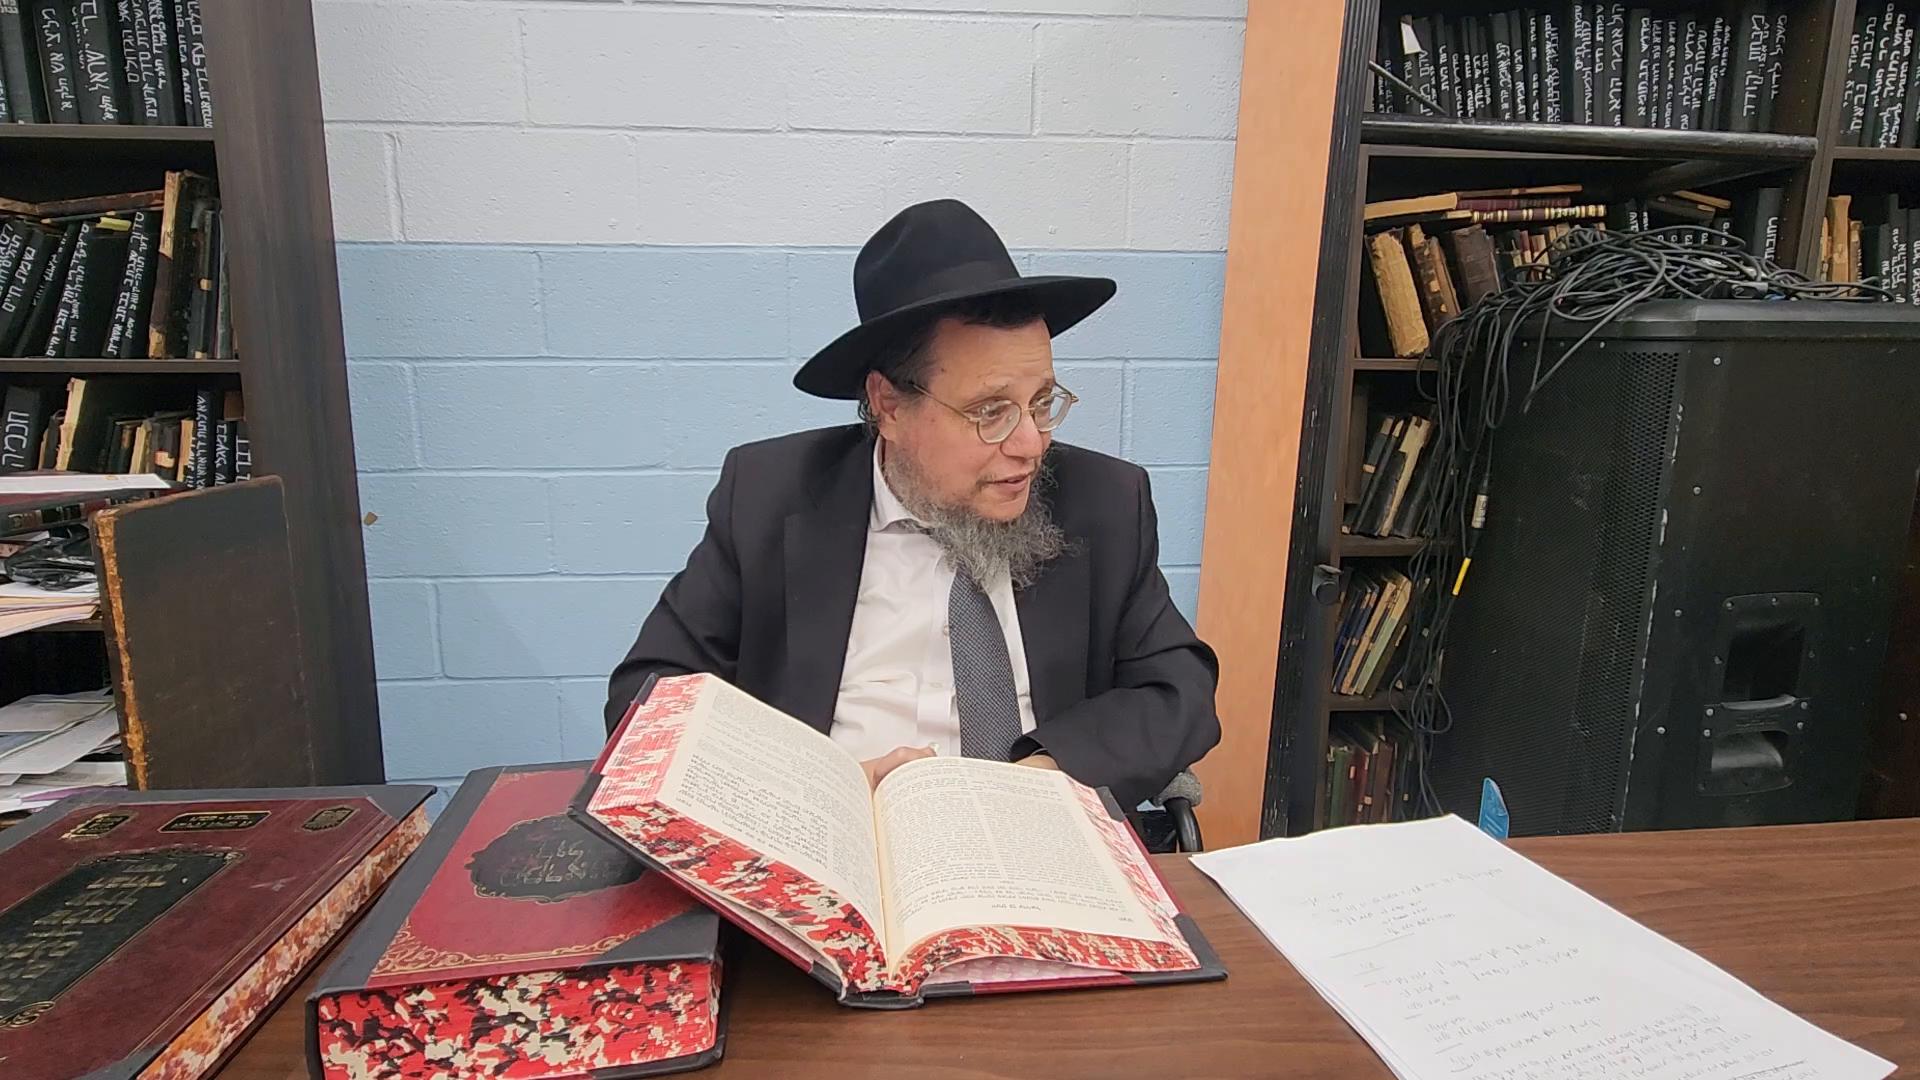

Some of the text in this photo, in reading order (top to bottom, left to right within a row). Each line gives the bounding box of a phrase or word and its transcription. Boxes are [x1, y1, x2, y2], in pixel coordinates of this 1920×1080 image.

[1606, 3, 1625, 26] קול
[1639, 16, 1651, 53] מדרש
[1882, 2, 1895, 31] ספר
[1609, 28, 1624, 71] אומר
[1684, 20, 1697, 61] מדרש
[1694, 29, 1707, 75] שמחת
[1766, 14, 1788, 100] משכיל לדוד
[1859, 16, 1878, 69] נתיבות
[50, 52, 65, 74] אש
[85, 42, 111, 92] ישראל
[139, 51, 154, 81] סדר
[1882, 50, 1901, 99] התורה
[1607, 77, 1623, 112] קרא
[1896, 243, 1908, 285] אהבת
[1, 285, 22, 313] חיים
[2, 410, 29, 468] חכמה
